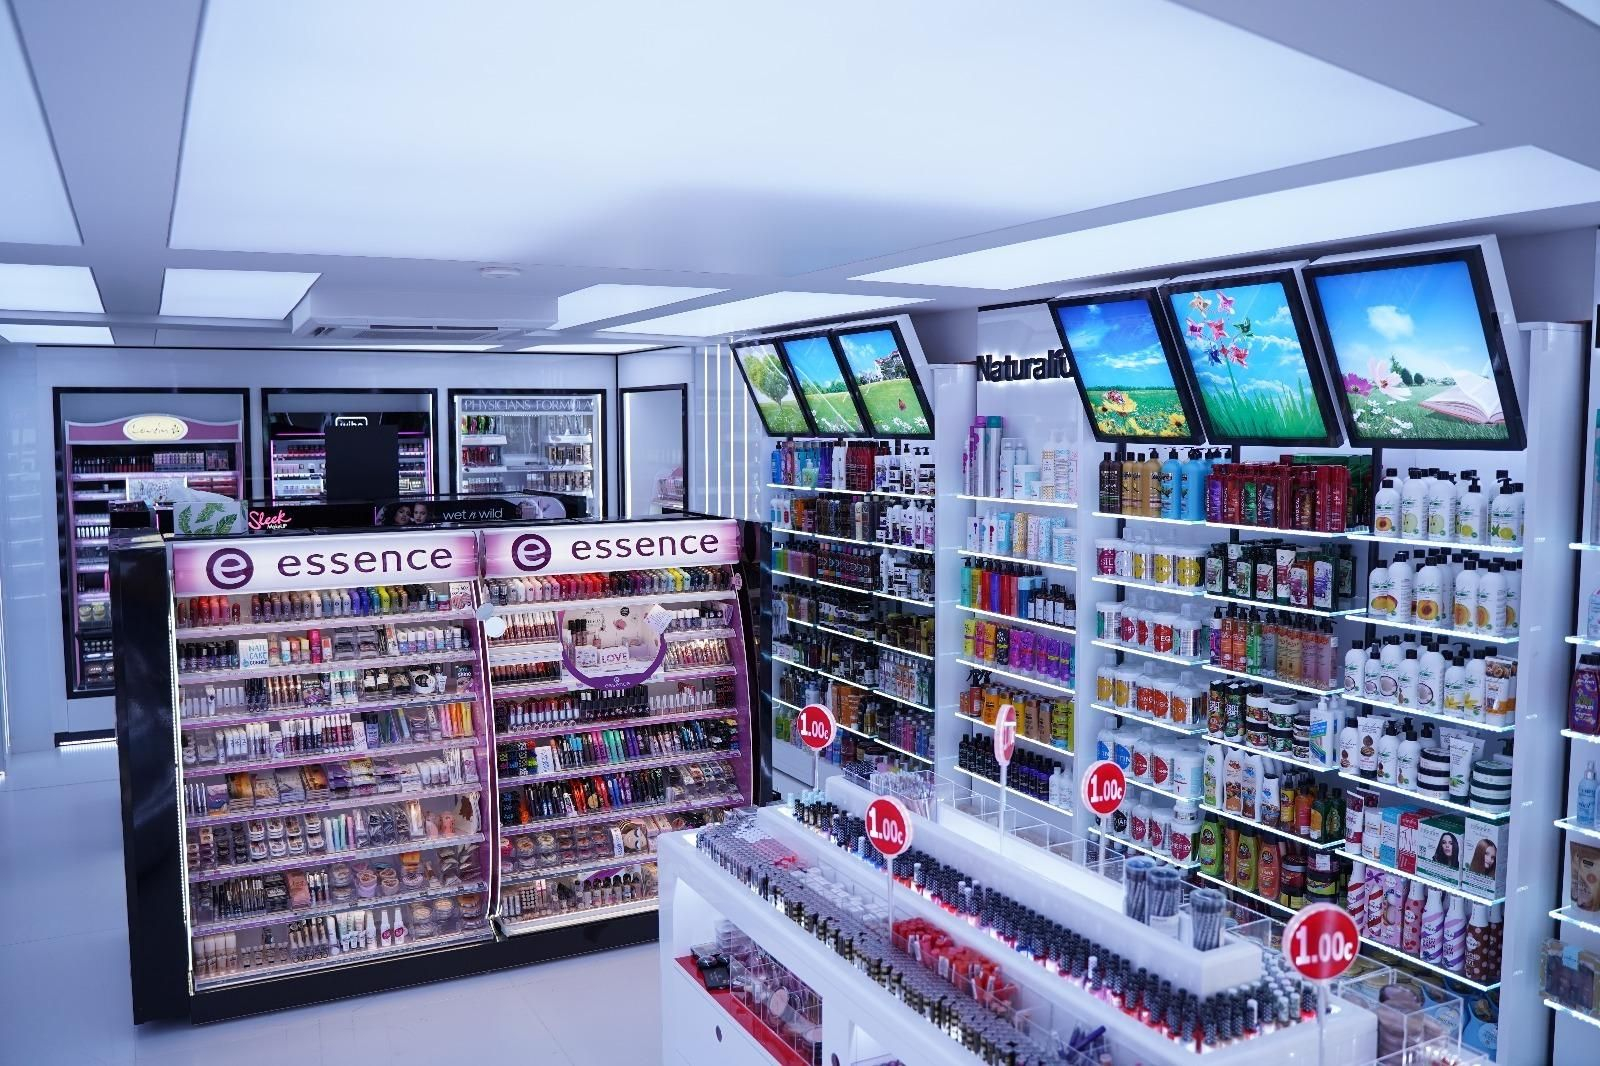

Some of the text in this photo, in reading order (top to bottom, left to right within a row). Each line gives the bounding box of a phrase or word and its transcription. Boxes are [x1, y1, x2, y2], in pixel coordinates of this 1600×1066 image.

[464, 400, 593, 411] PHYSICIANS FORMULA
[248, 509, 292, 530] Sleek
[442, 507, 503, 521] wet n wild
[571, 533, 719, 561] essence
[277, 547, 453, 577] essence
[601, 652, 628, 664] LOVE
